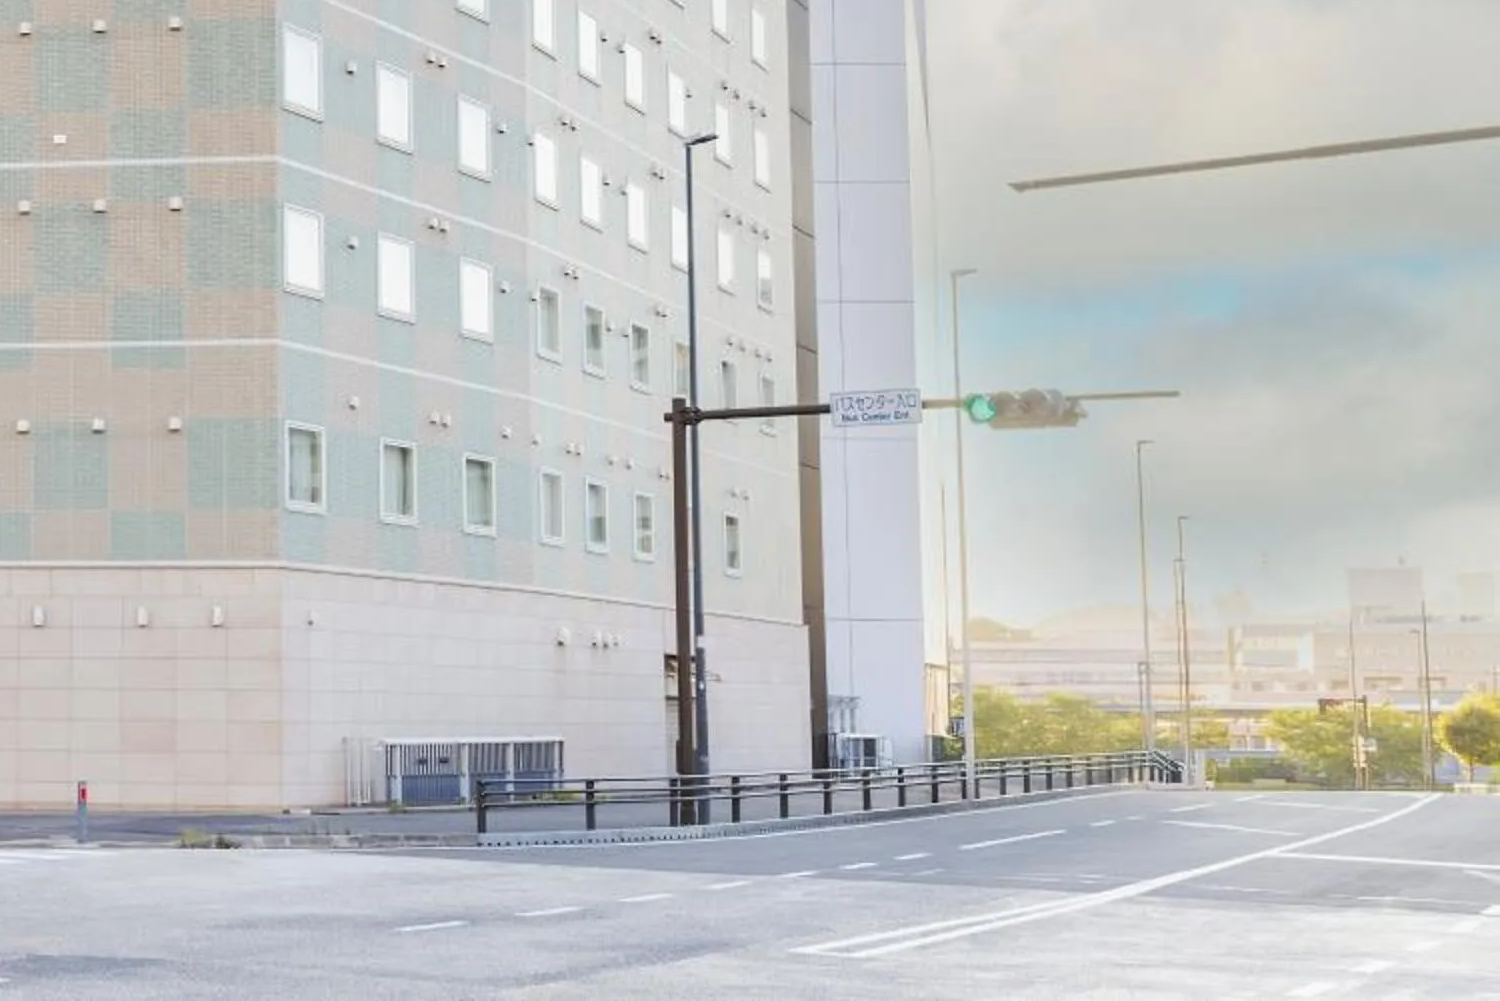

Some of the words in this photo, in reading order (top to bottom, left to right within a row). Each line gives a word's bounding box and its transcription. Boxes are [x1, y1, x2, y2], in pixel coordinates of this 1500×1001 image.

[834, 393, 917, 412] バスセンター入口
